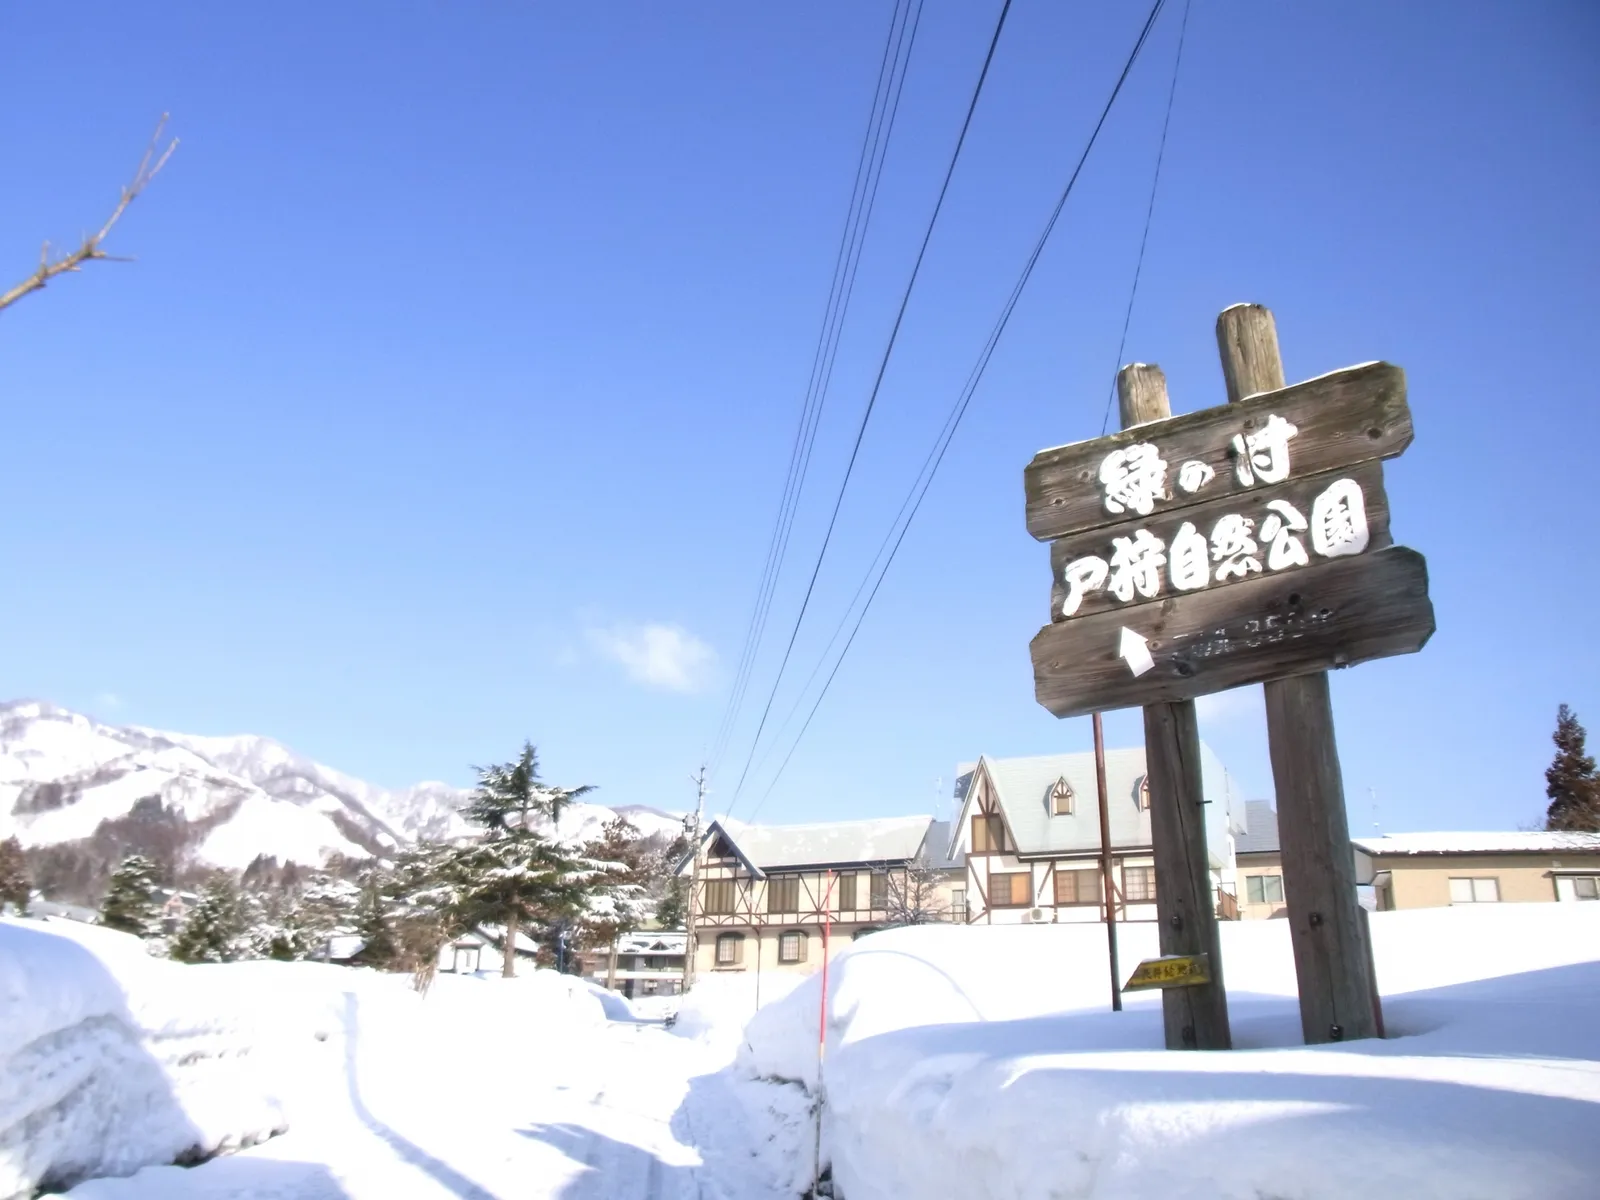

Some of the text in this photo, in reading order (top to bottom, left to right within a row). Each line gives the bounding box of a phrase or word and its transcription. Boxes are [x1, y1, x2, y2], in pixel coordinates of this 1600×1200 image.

[1061, 477, 1370, 617] 戸狩自然公園
